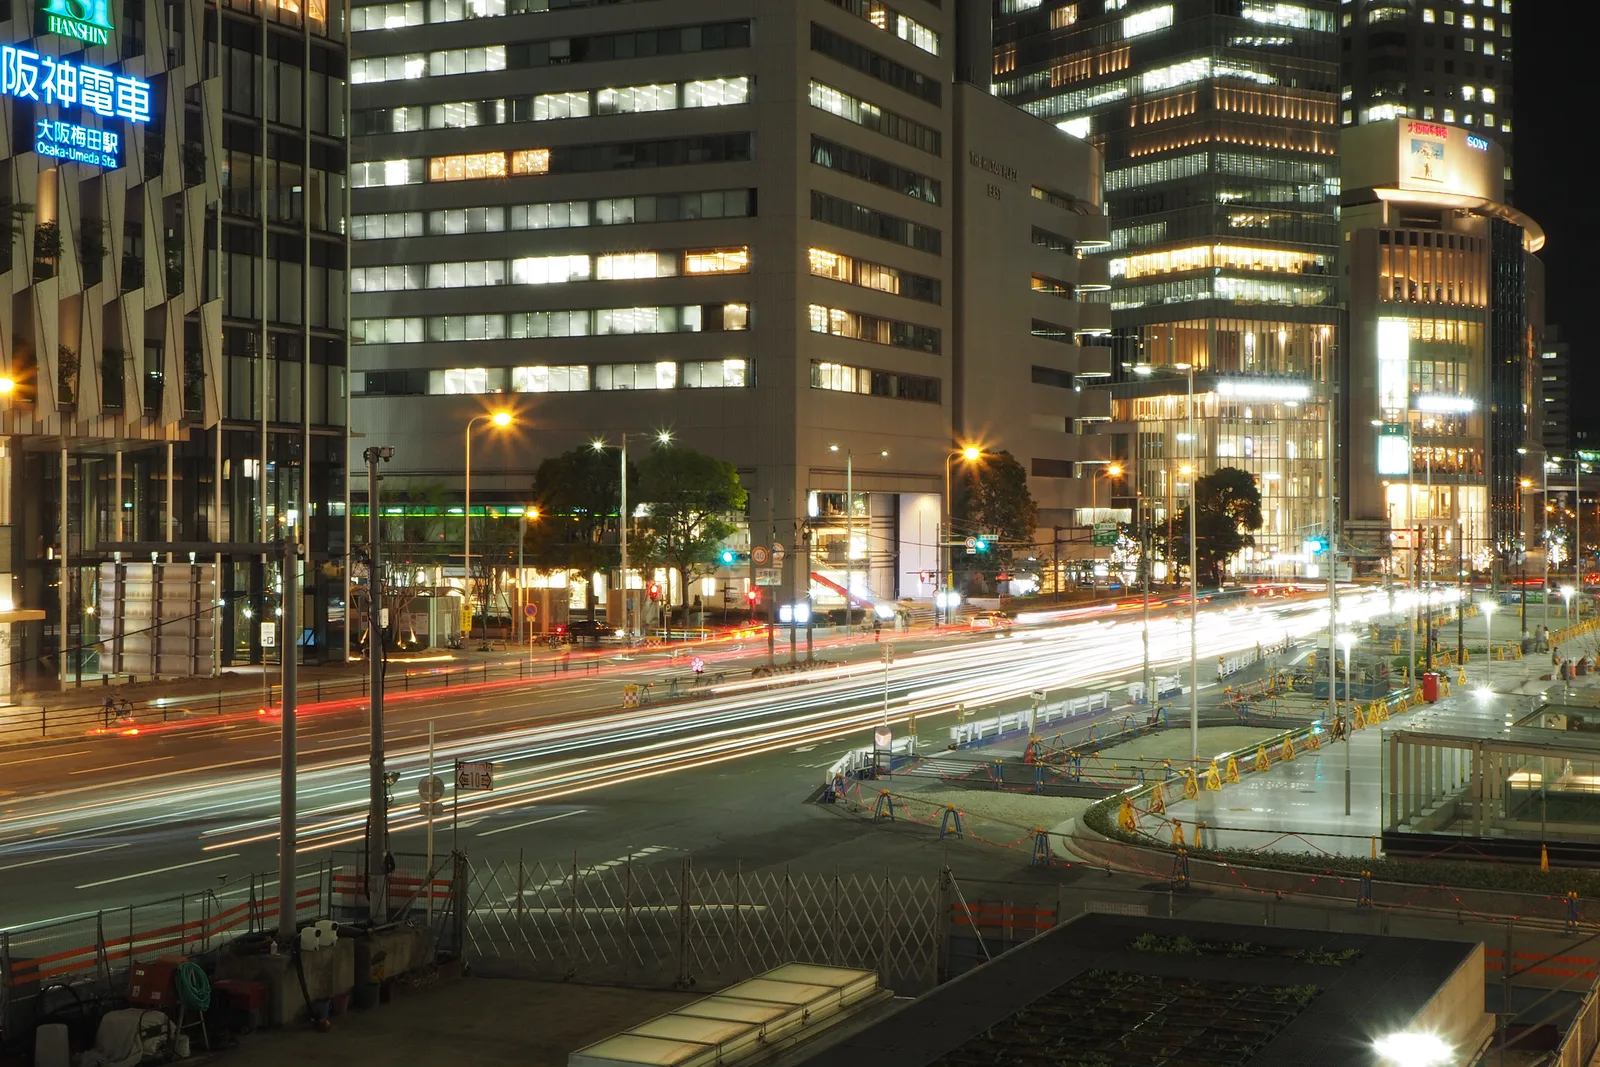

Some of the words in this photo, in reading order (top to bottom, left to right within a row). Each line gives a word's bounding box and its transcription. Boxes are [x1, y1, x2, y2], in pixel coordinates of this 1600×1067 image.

[50, 16, 107, 45] HANSHIN
[1, 45, 151, 123] 阪神電車
[37, 117, 118, 155] 大阪梅田駅
[1467, 136, 1489, 151] SONY
[102, 154, 118, 169] Sta.
